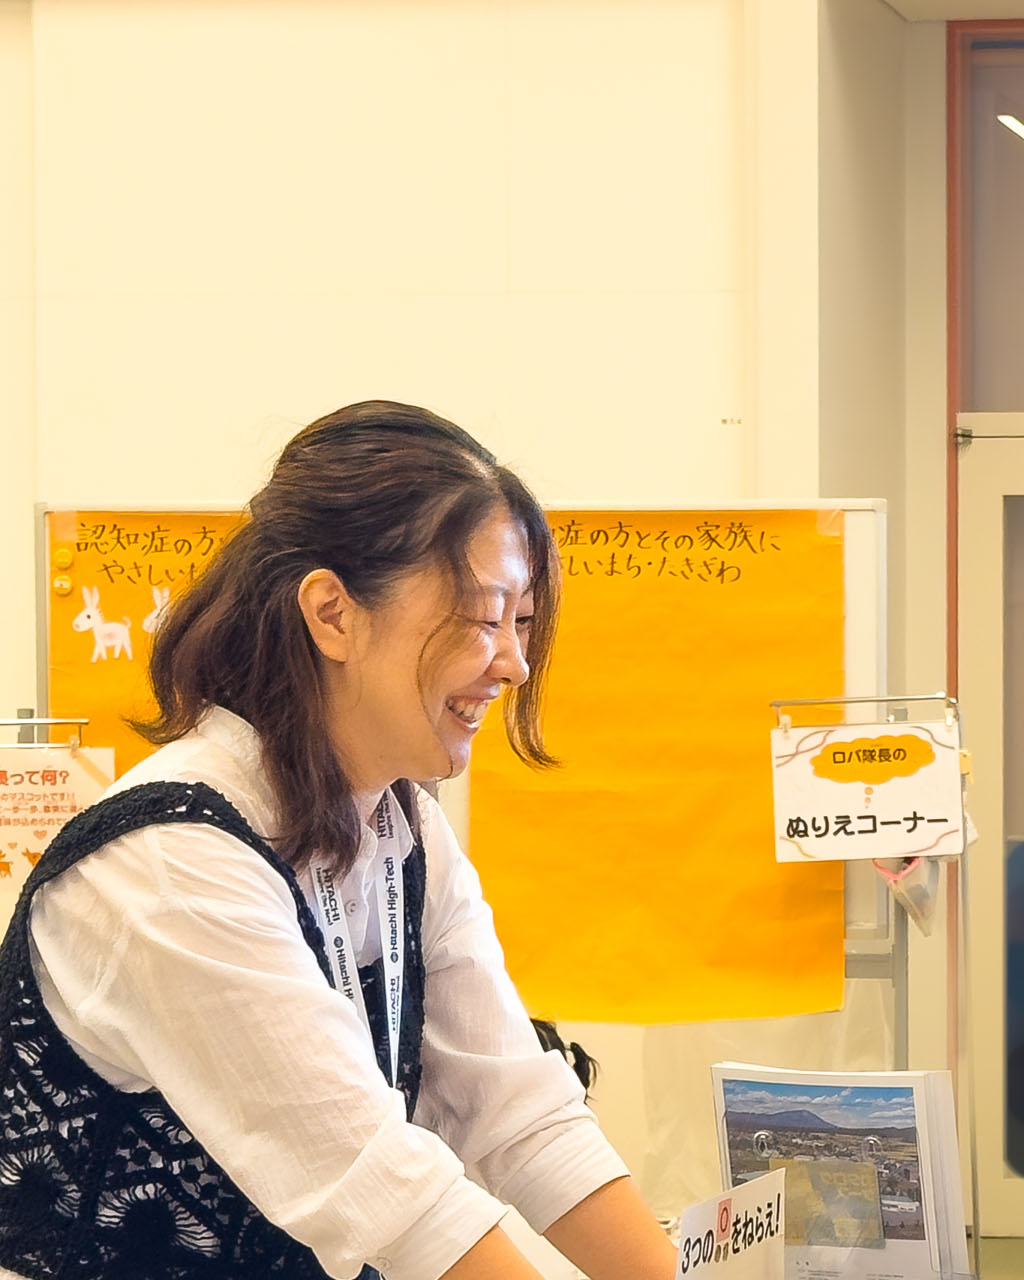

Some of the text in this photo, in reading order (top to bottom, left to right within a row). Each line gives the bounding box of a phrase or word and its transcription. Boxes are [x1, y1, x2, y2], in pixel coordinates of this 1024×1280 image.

[76, 522, 225, 557] 認知症の方
[551, 519, 782, 554] 症の方とその家族に
[560, 552, 742, 585] しいまち・たきざわ
[832, 748, 907, 764] ロバ隊長の
[786, 811, 949, 839] ぬりえコーナー
[322, 868, 341, 922] HITACHI
[383, 856, 399, 911] High-Tech
[336, 948, 352, 987] Hitachi
